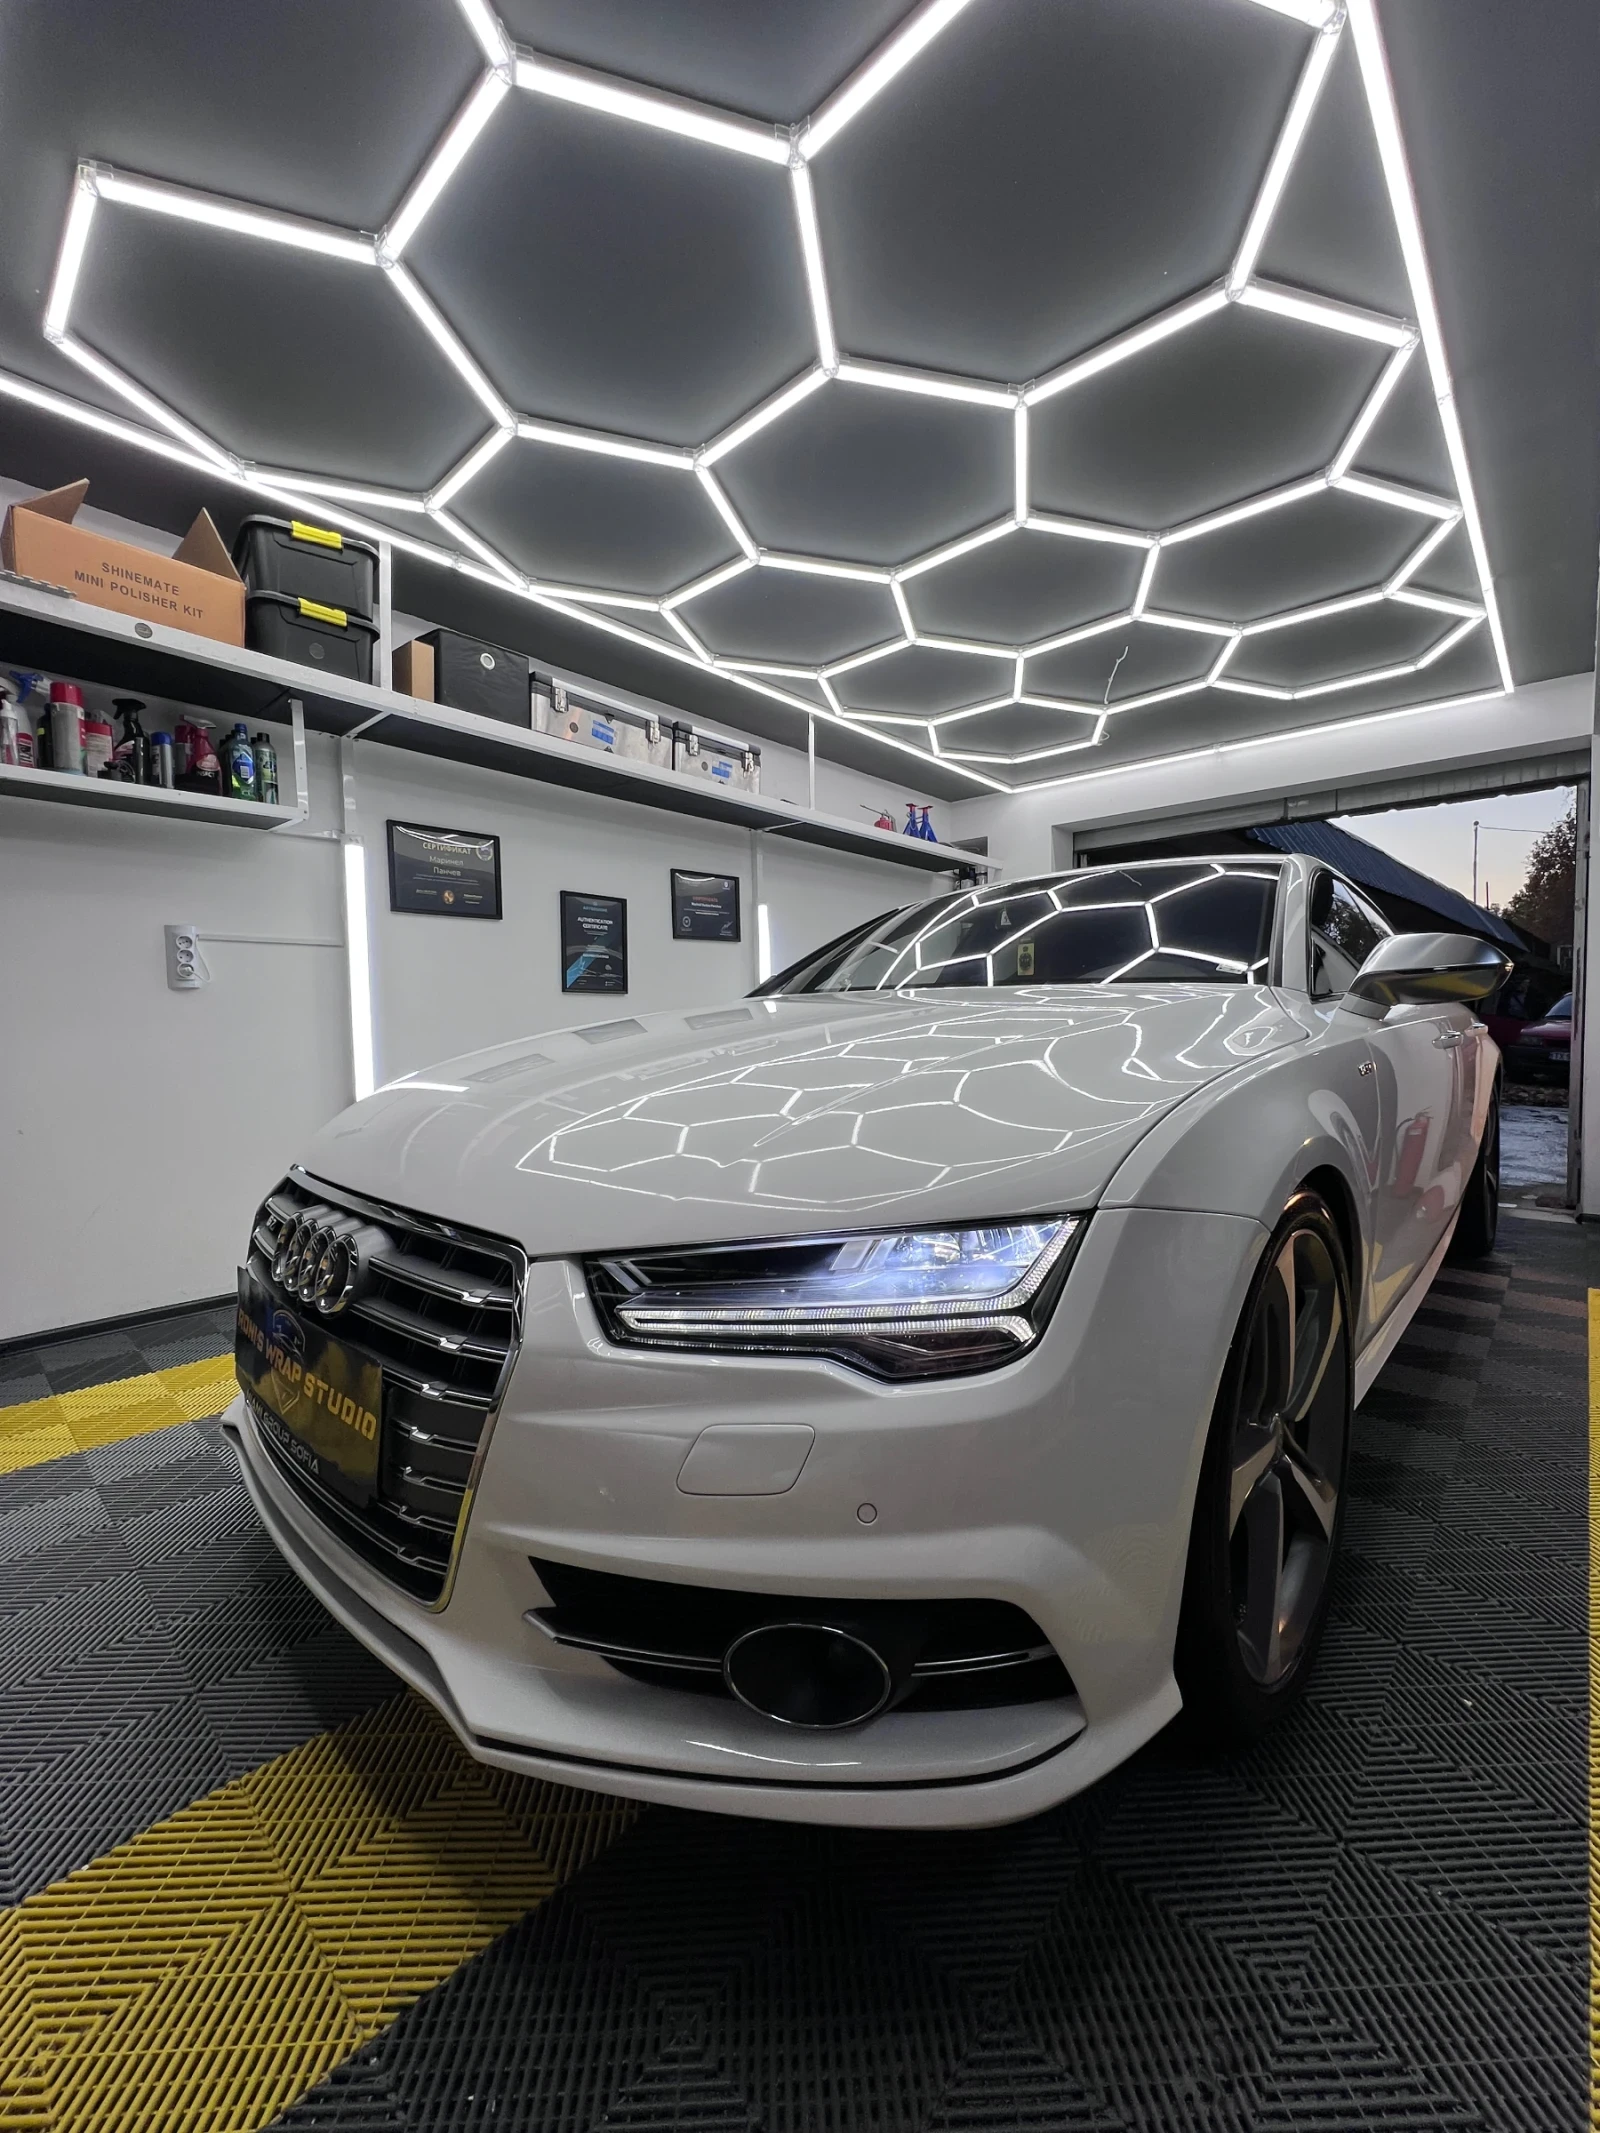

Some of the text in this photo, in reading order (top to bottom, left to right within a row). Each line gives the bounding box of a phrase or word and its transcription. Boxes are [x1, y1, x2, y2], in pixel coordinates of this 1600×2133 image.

[74, 570, 203, 619] MINI POLISHER KIT
[102, 562, 180, 596] SHINEMATE
[422, 841, 472, 855] СЕРТИФИКАТ
[265, 1337, 302, 1383] WRAP
[303, 1372, 377, 1441] STUDIO
[290, 1439, 320, 1475] SOFIA
